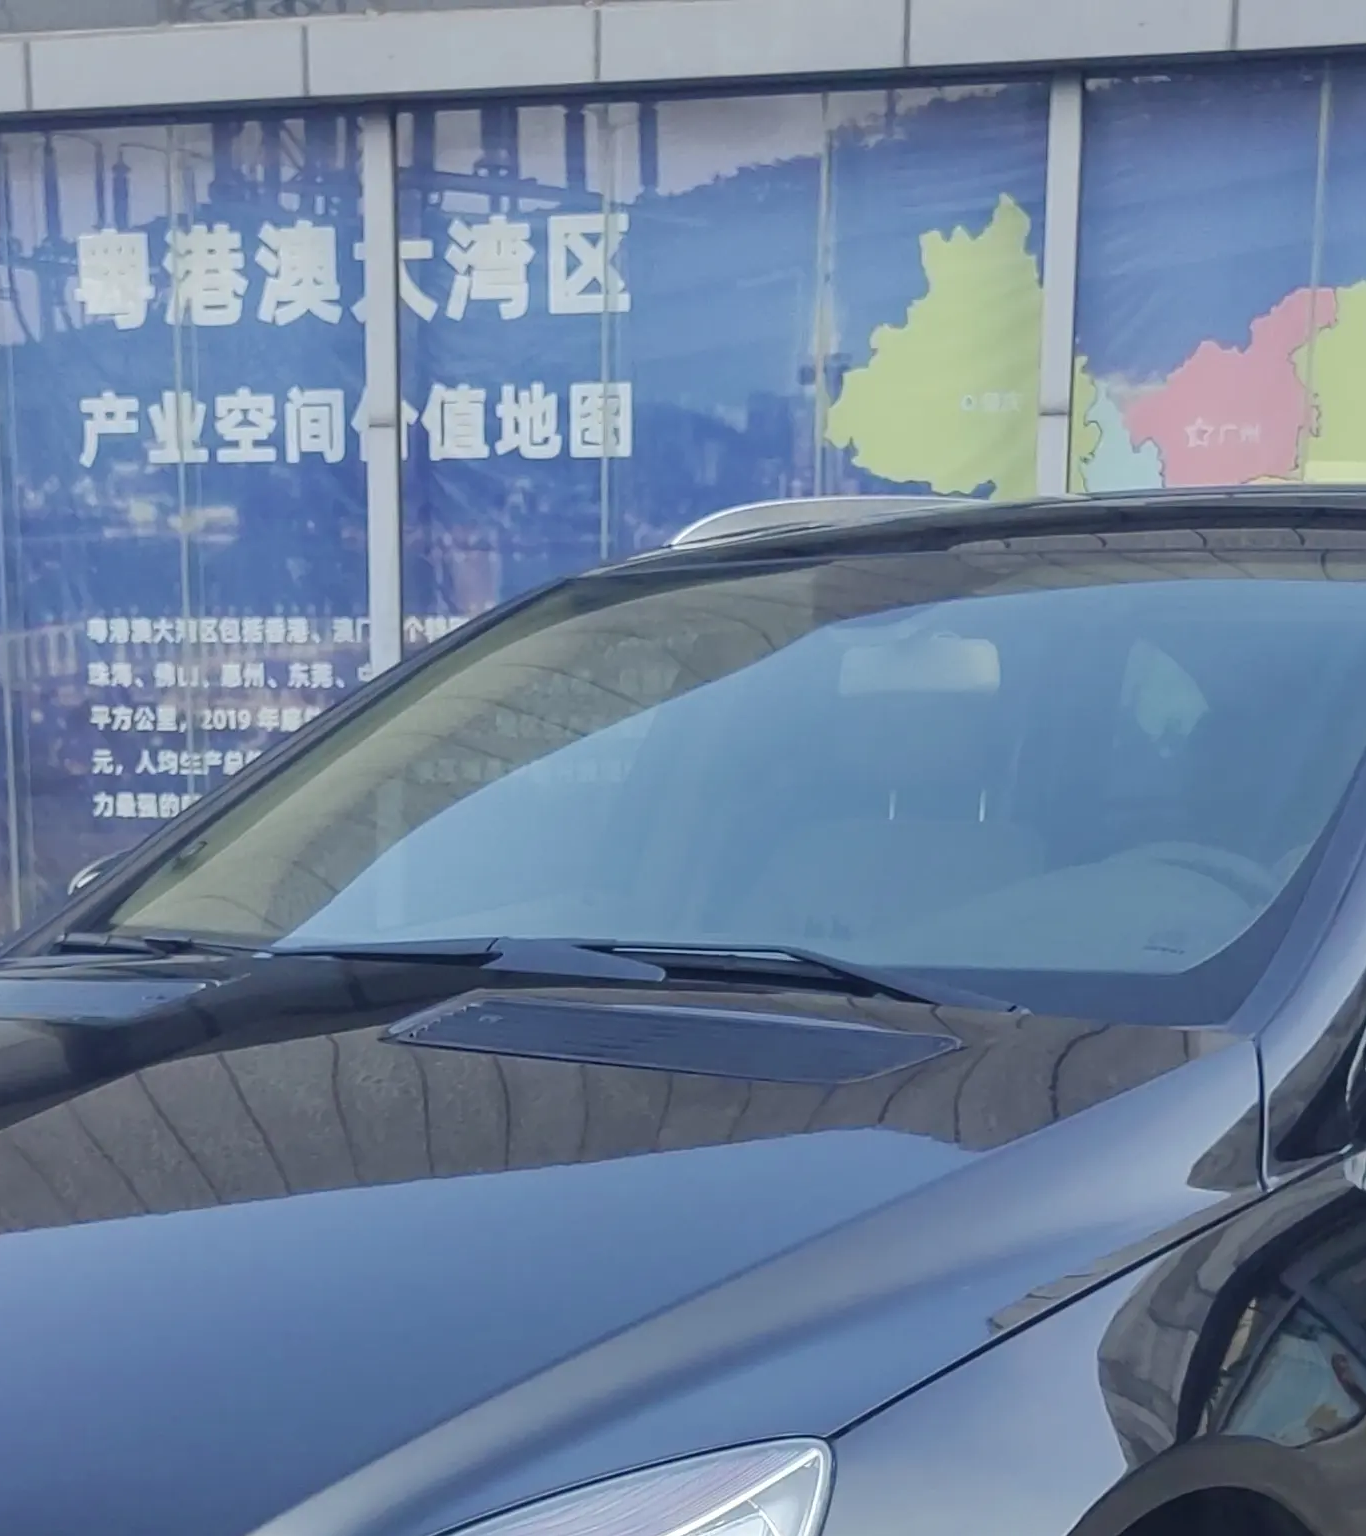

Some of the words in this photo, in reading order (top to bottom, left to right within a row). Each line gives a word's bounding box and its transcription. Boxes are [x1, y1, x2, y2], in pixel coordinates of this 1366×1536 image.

[75, 212, 632, 330] 粤港澳大湾区
